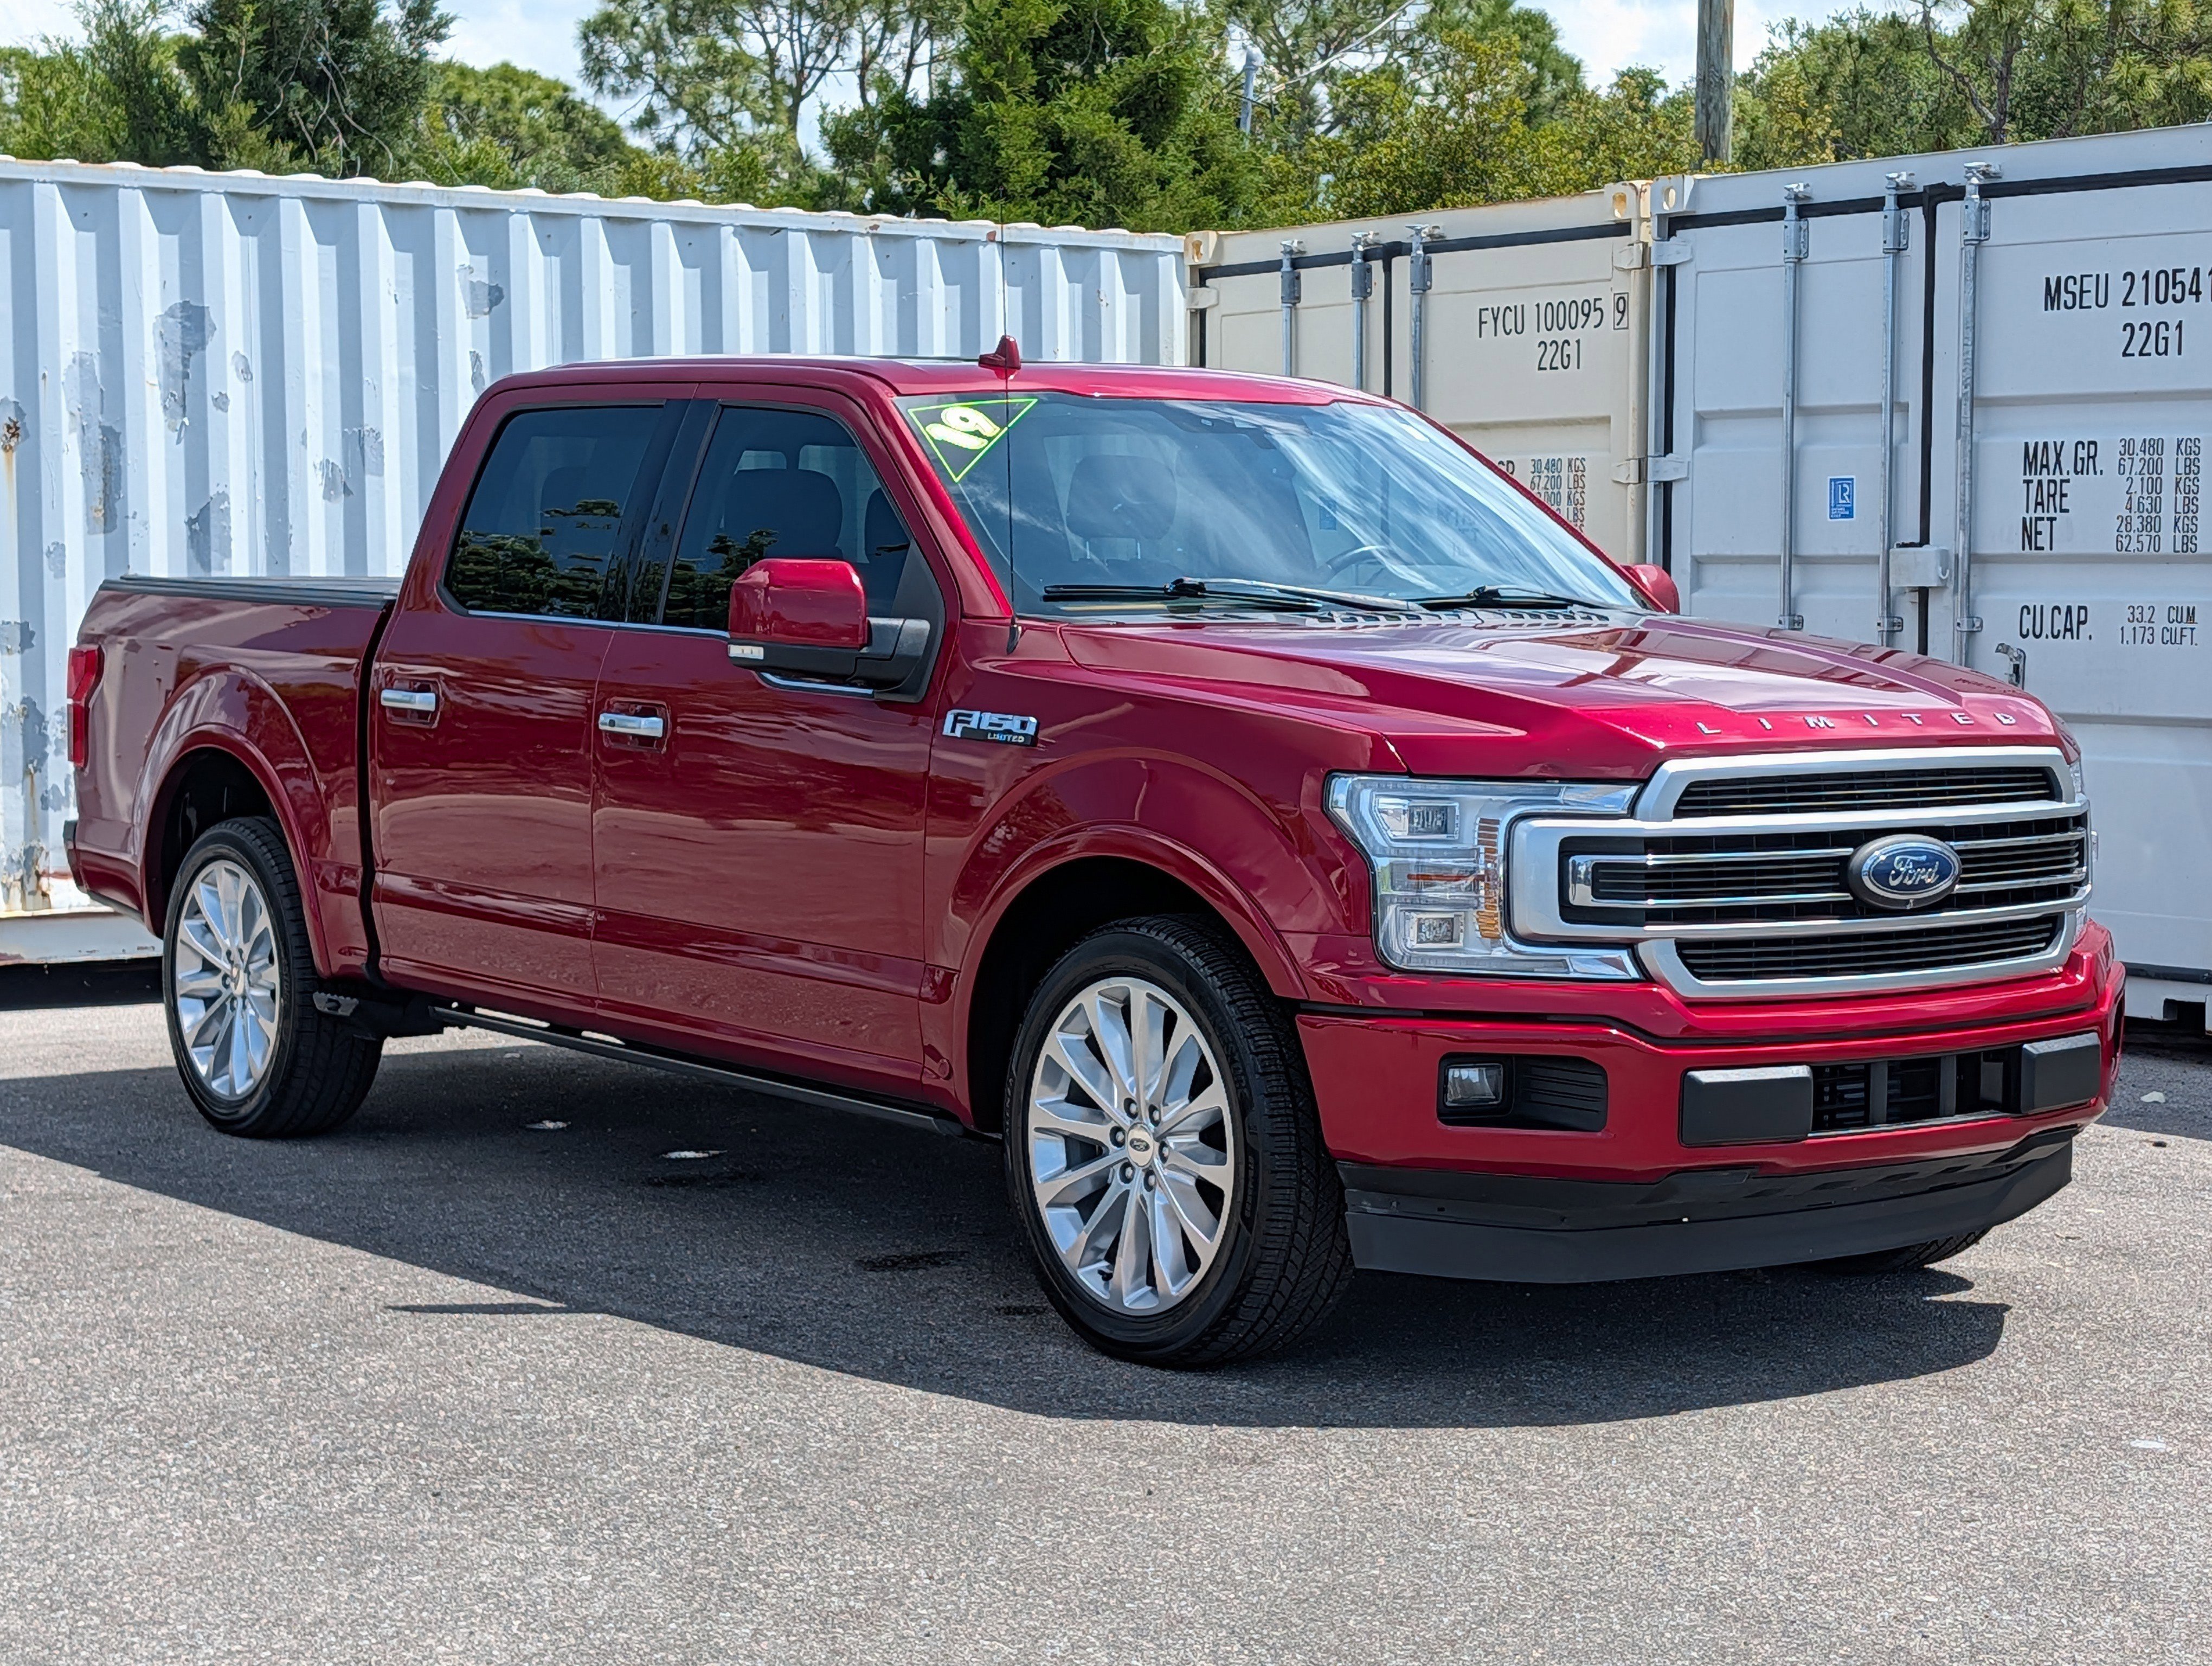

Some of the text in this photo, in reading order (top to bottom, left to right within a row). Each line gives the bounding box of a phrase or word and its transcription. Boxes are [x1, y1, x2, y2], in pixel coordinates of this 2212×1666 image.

[2044, 273, 2109, 311] MSEU
[1478, 294, 1627, 338] FYCU 100095 9
[2122, 320, 2183, 357] 22G1
[1538, 338, 1580, 371] 22G1
[925, 406, 1001, 450] 19
[2119, 437, 2201, 457] 30.480 KGS
[1530, 458, 1562, 475] 30.480
[1567, 457, 1586, 473] KGS
[2023, 440, 2104, 476] MAX.GR.
[2118, 457, 2201, 476] 67.200 LBS
[1529, 473, 1586, 491] 67.200 LBS
[2125, 476, 2200, 495] 2.100 KGS
[1566, 490, 1586, 506] KGS
[2022, 478, 2070, 513] TARE
[2125, 496, 2200, 515] 4.630 LBS
[1566, 507, 1585, 523] LBS
[2116, 515, 2198, 534] 28.380 KGS
[2021, 516, 2057, 551] NET
[2115, 534, 2198, 553] 62.570 LBS
[2019, 604, 2092, 640] CU.CAP.
[2127, 605, 2156, 624] 33.2
[2120, 626, 2155, 645] 1.173
[1695, 712, 2017, 736] LIMITED
[1888, 854, 1940, 886] Ford
